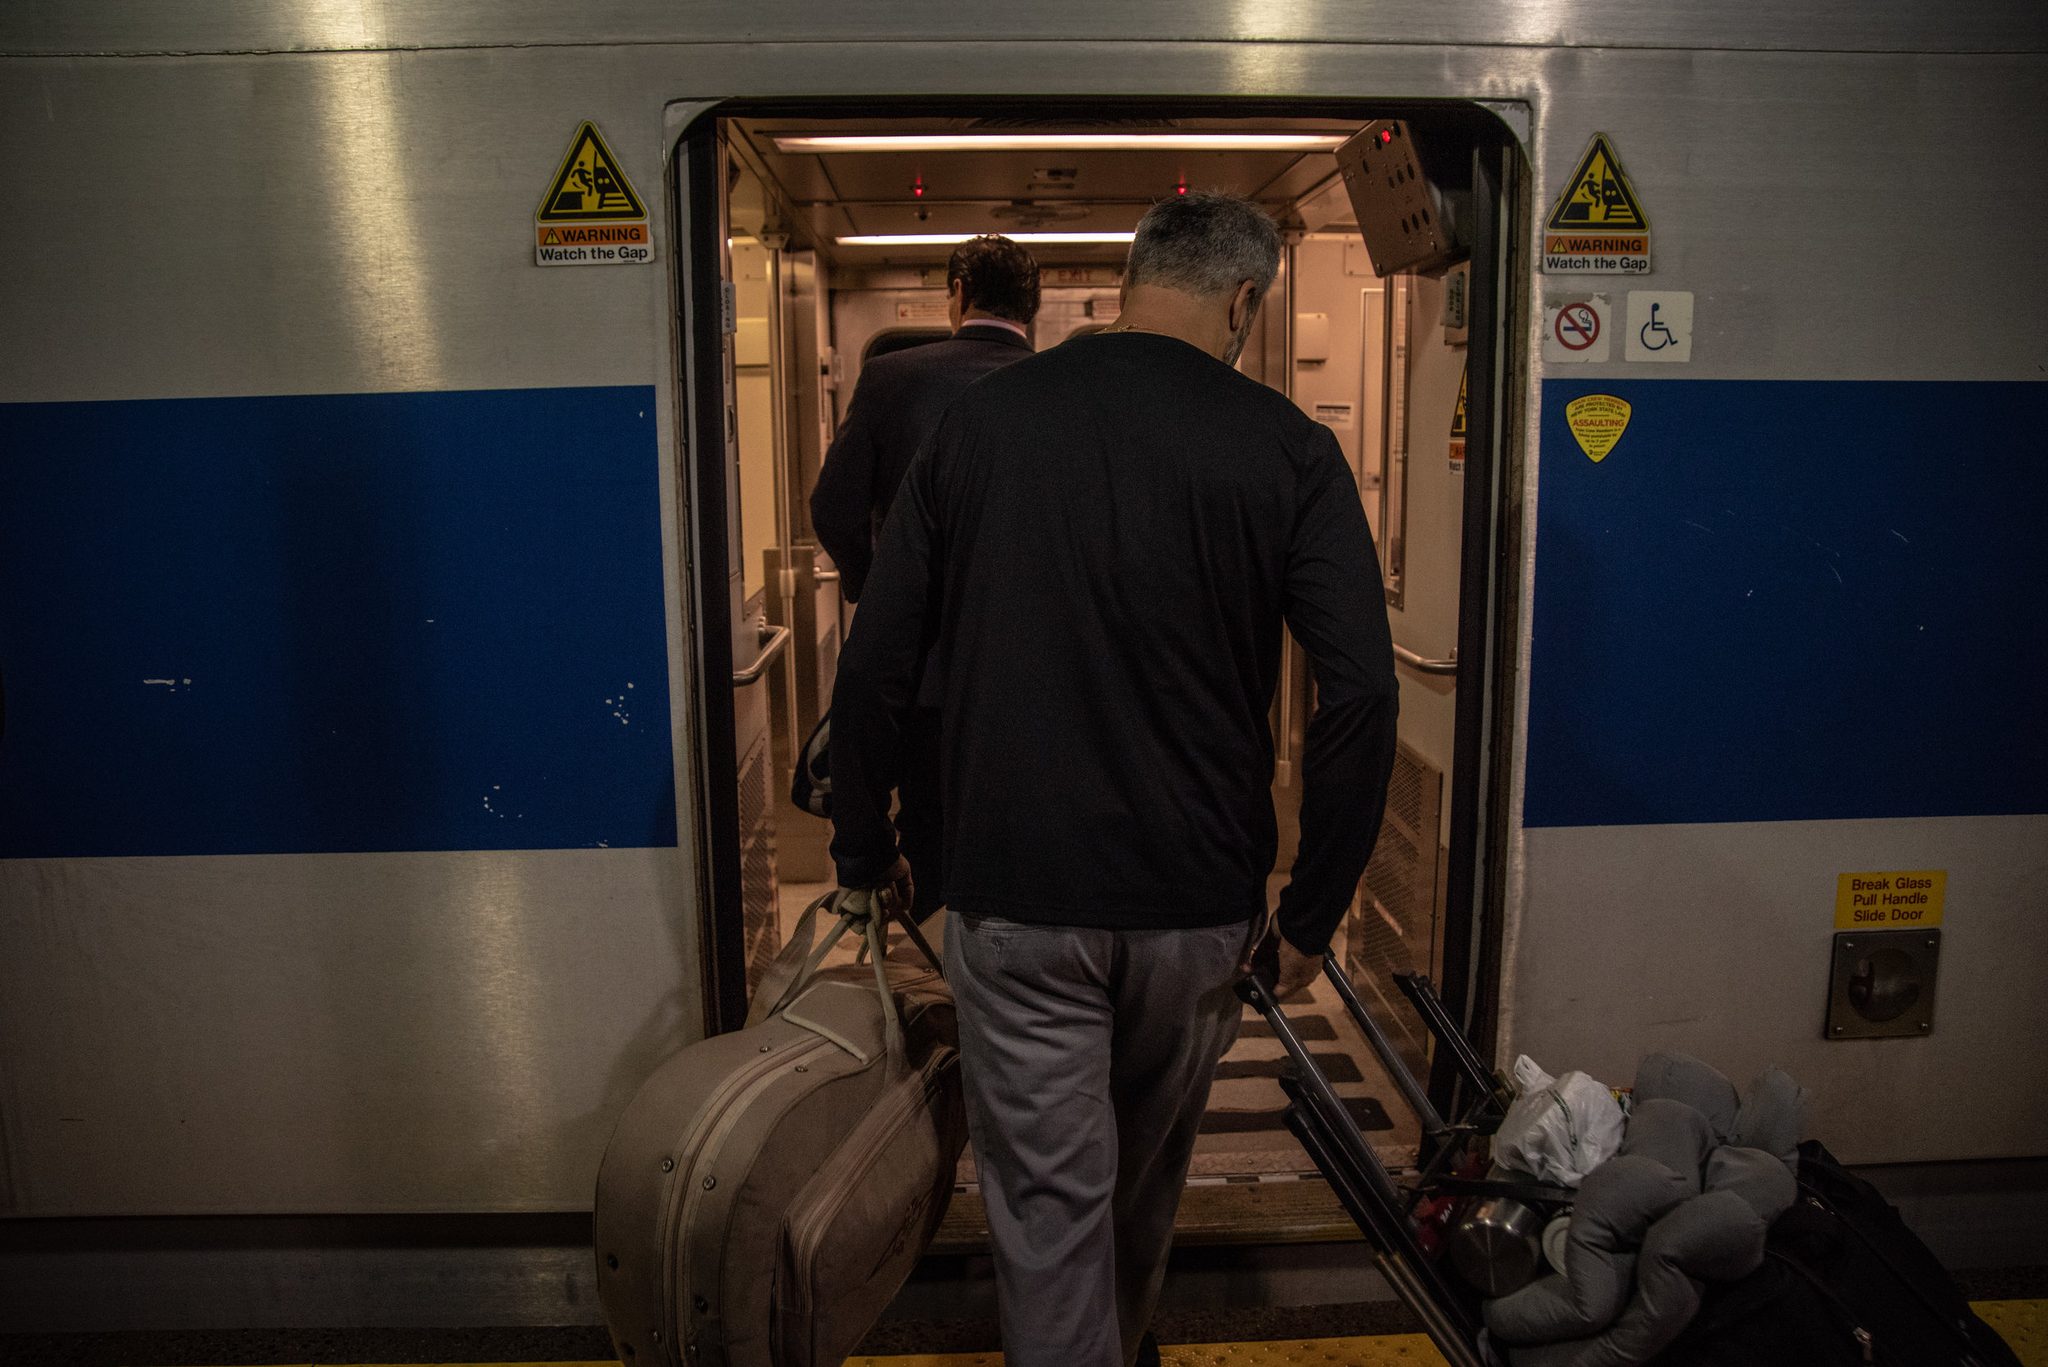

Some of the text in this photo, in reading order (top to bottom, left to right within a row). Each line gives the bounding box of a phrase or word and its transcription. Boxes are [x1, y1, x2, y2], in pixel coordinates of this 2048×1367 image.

[562, 228, 640, 242] WARNING
[1569, 240, 1642, 251] WARNING
[540, 246, 648, 260] Watch the Gap
[1547, 257, 1647, 271] Watch the Gap
[1852, 878, 1932, 891] Break Glass
[1853, 893, 1928, 906] Pull Handle
[1854, 909, 1924, 921] Slide Door
